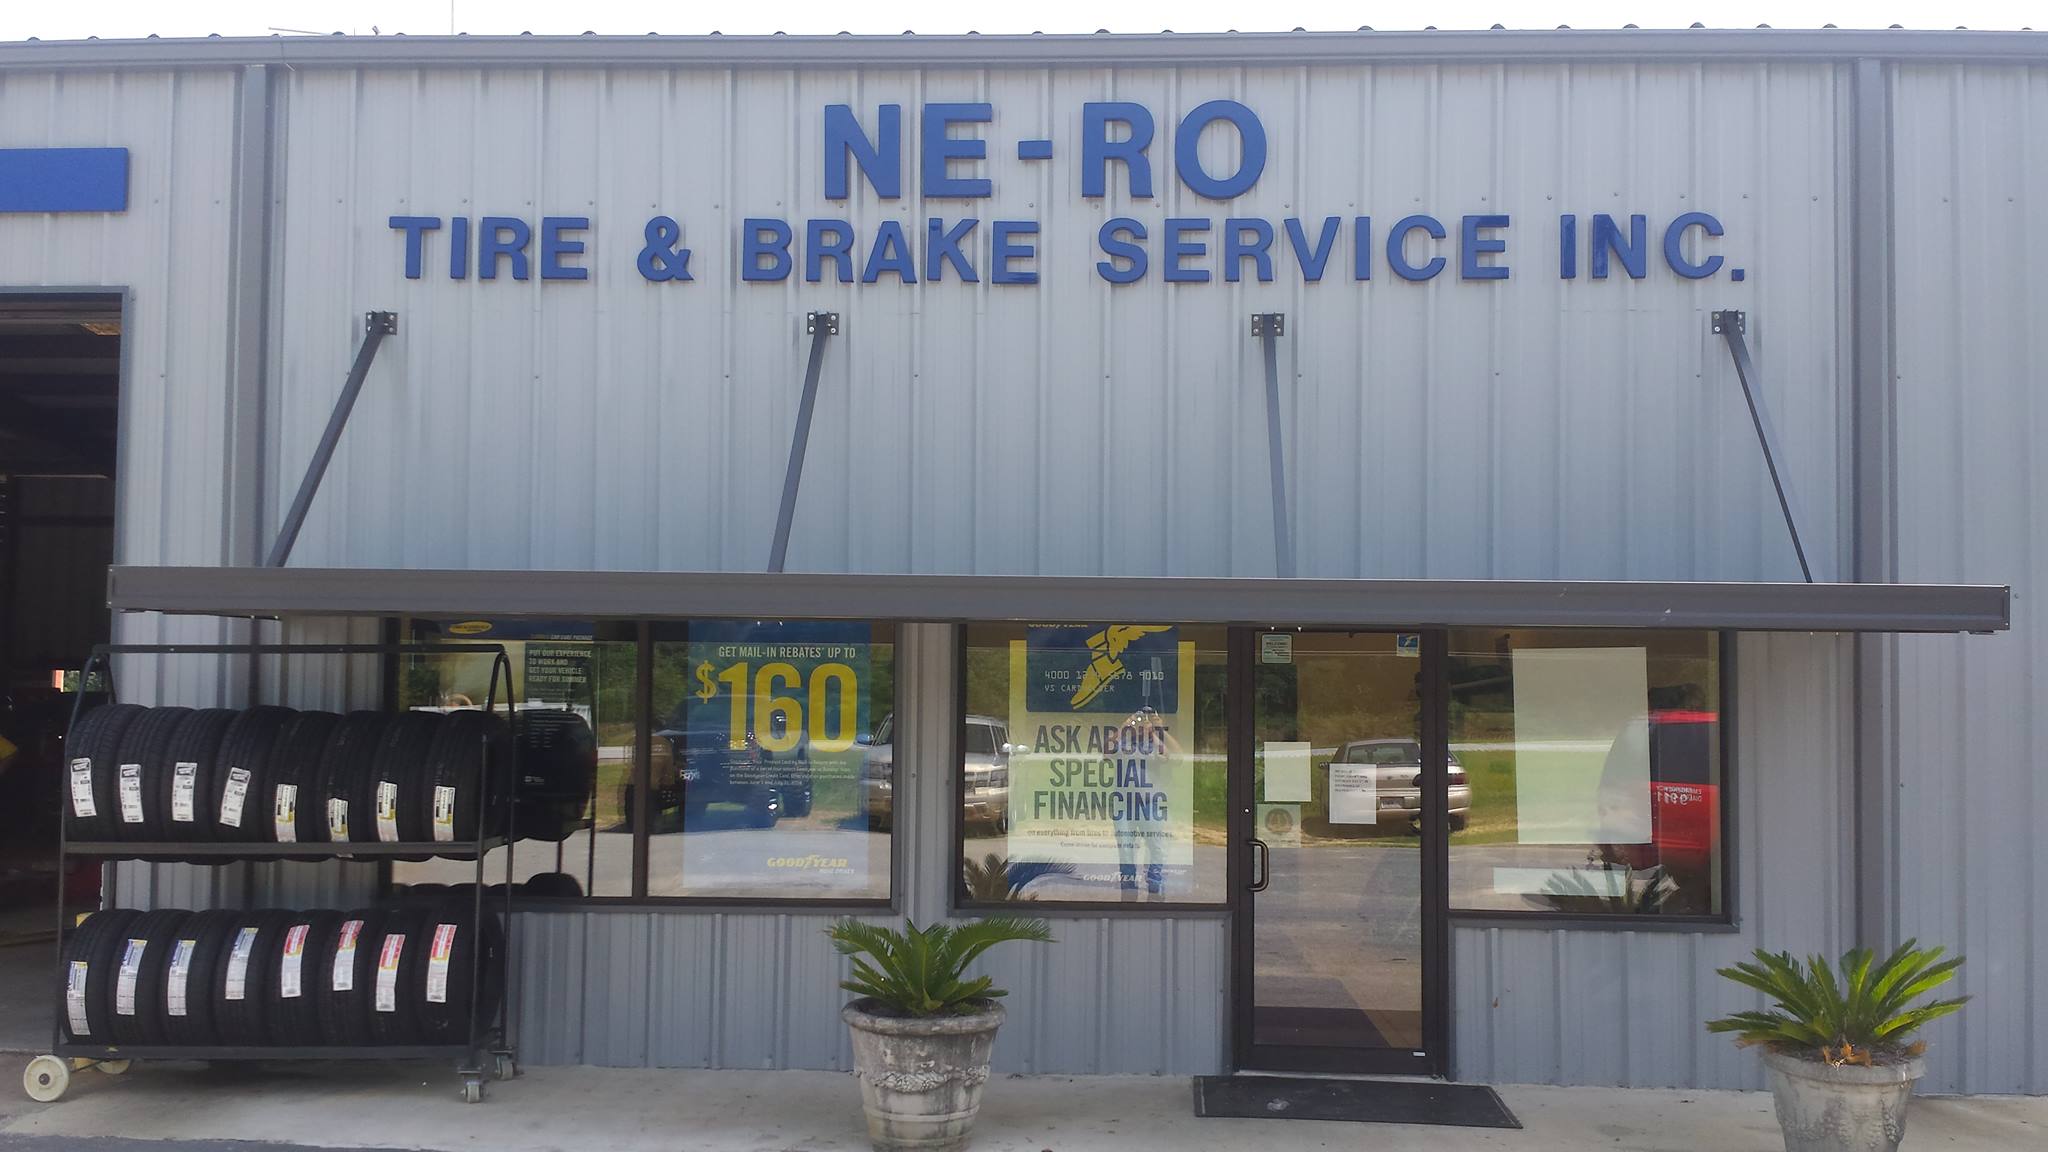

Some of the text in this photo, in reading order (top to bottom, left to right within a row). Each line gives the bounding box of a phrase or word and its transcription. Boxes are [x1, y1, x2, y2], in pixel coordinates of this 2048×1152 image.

[824, 100, 1267, 199] NE-RO
[389, 211, 1745, 285] TIRE & BRAKE SERVICE INC.
[718, 646, 736, 657] GET
[740, 646, 777, 658] MAIL-IN
[828, 646, 840, 658] UP
[844, 647, 856, 658] TO
[1045, 670, 1069, 680] 4000
[1034, 725, 1169, 755] ASK ABOUT
[1050, 758, 1153, 788] SPECIAL
[1034, 791, 1168, 821] FINANCING
